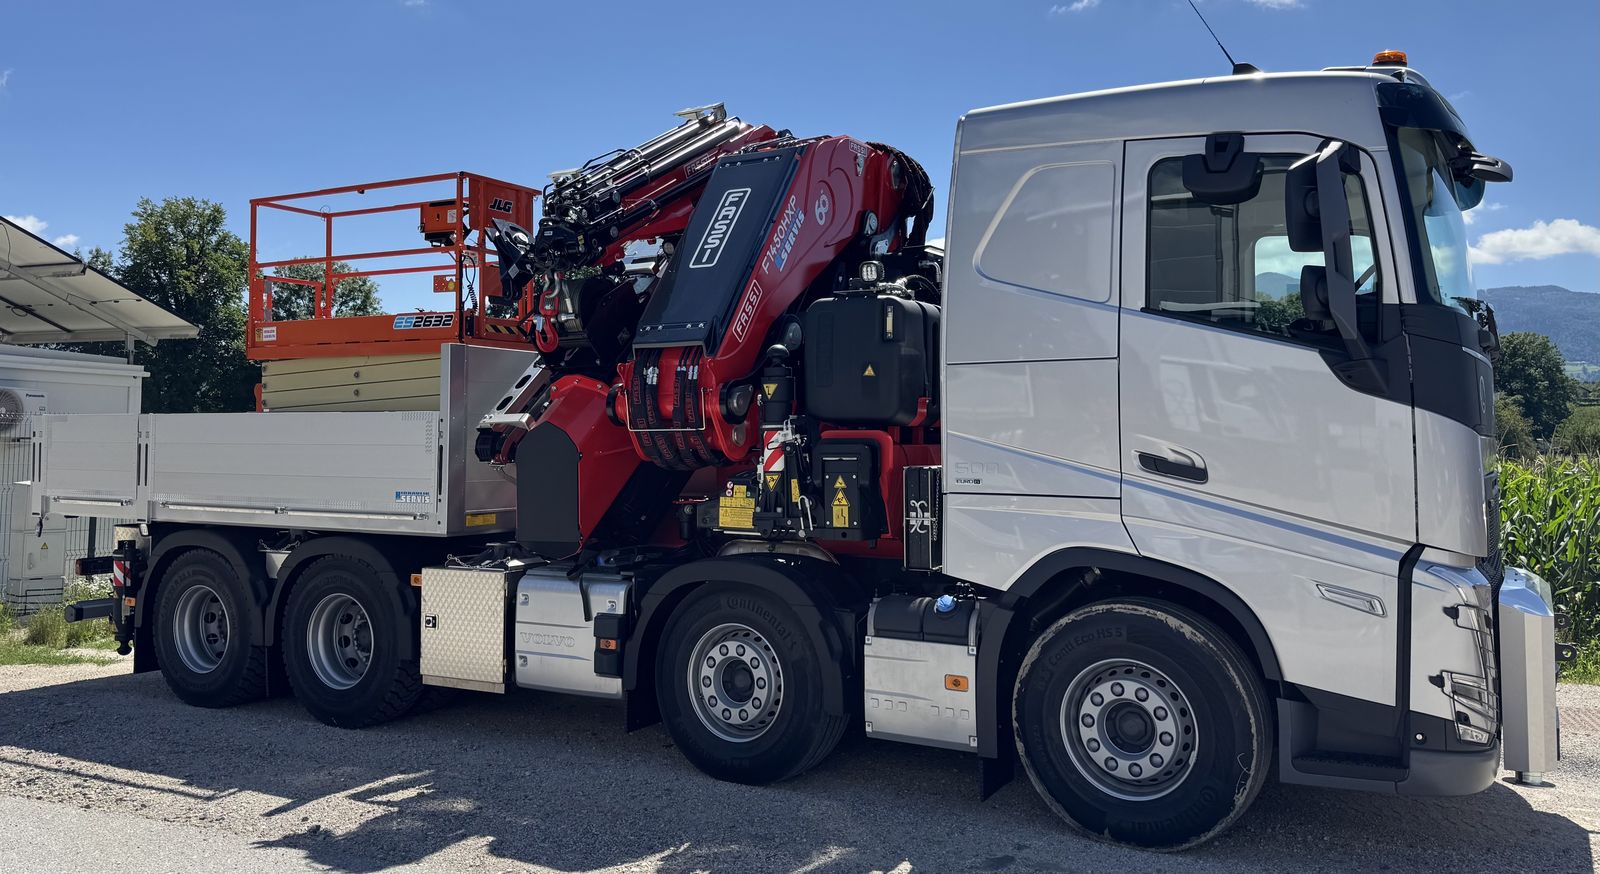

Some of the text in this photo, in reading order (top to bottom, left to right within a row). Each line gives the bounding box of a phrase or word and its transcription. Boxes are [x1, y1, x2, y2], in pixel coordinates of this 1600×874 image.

[489, 198, 513, 214] JLG
[702, 192, 744, 263] FASSI
[761, 194, 797, 275] F1450HXP
[780, 210, 806, 266] SERVIS
[393, 314, 455, 329] ES2632
[736, 286, 760, 336] FASSI
[400, 495, 430, 503] SERVIS
[727, 595, 793, 641] Continental
[519, 631, 576, 648] VOLVO
[1074, 633, 1095, 647] Eco
